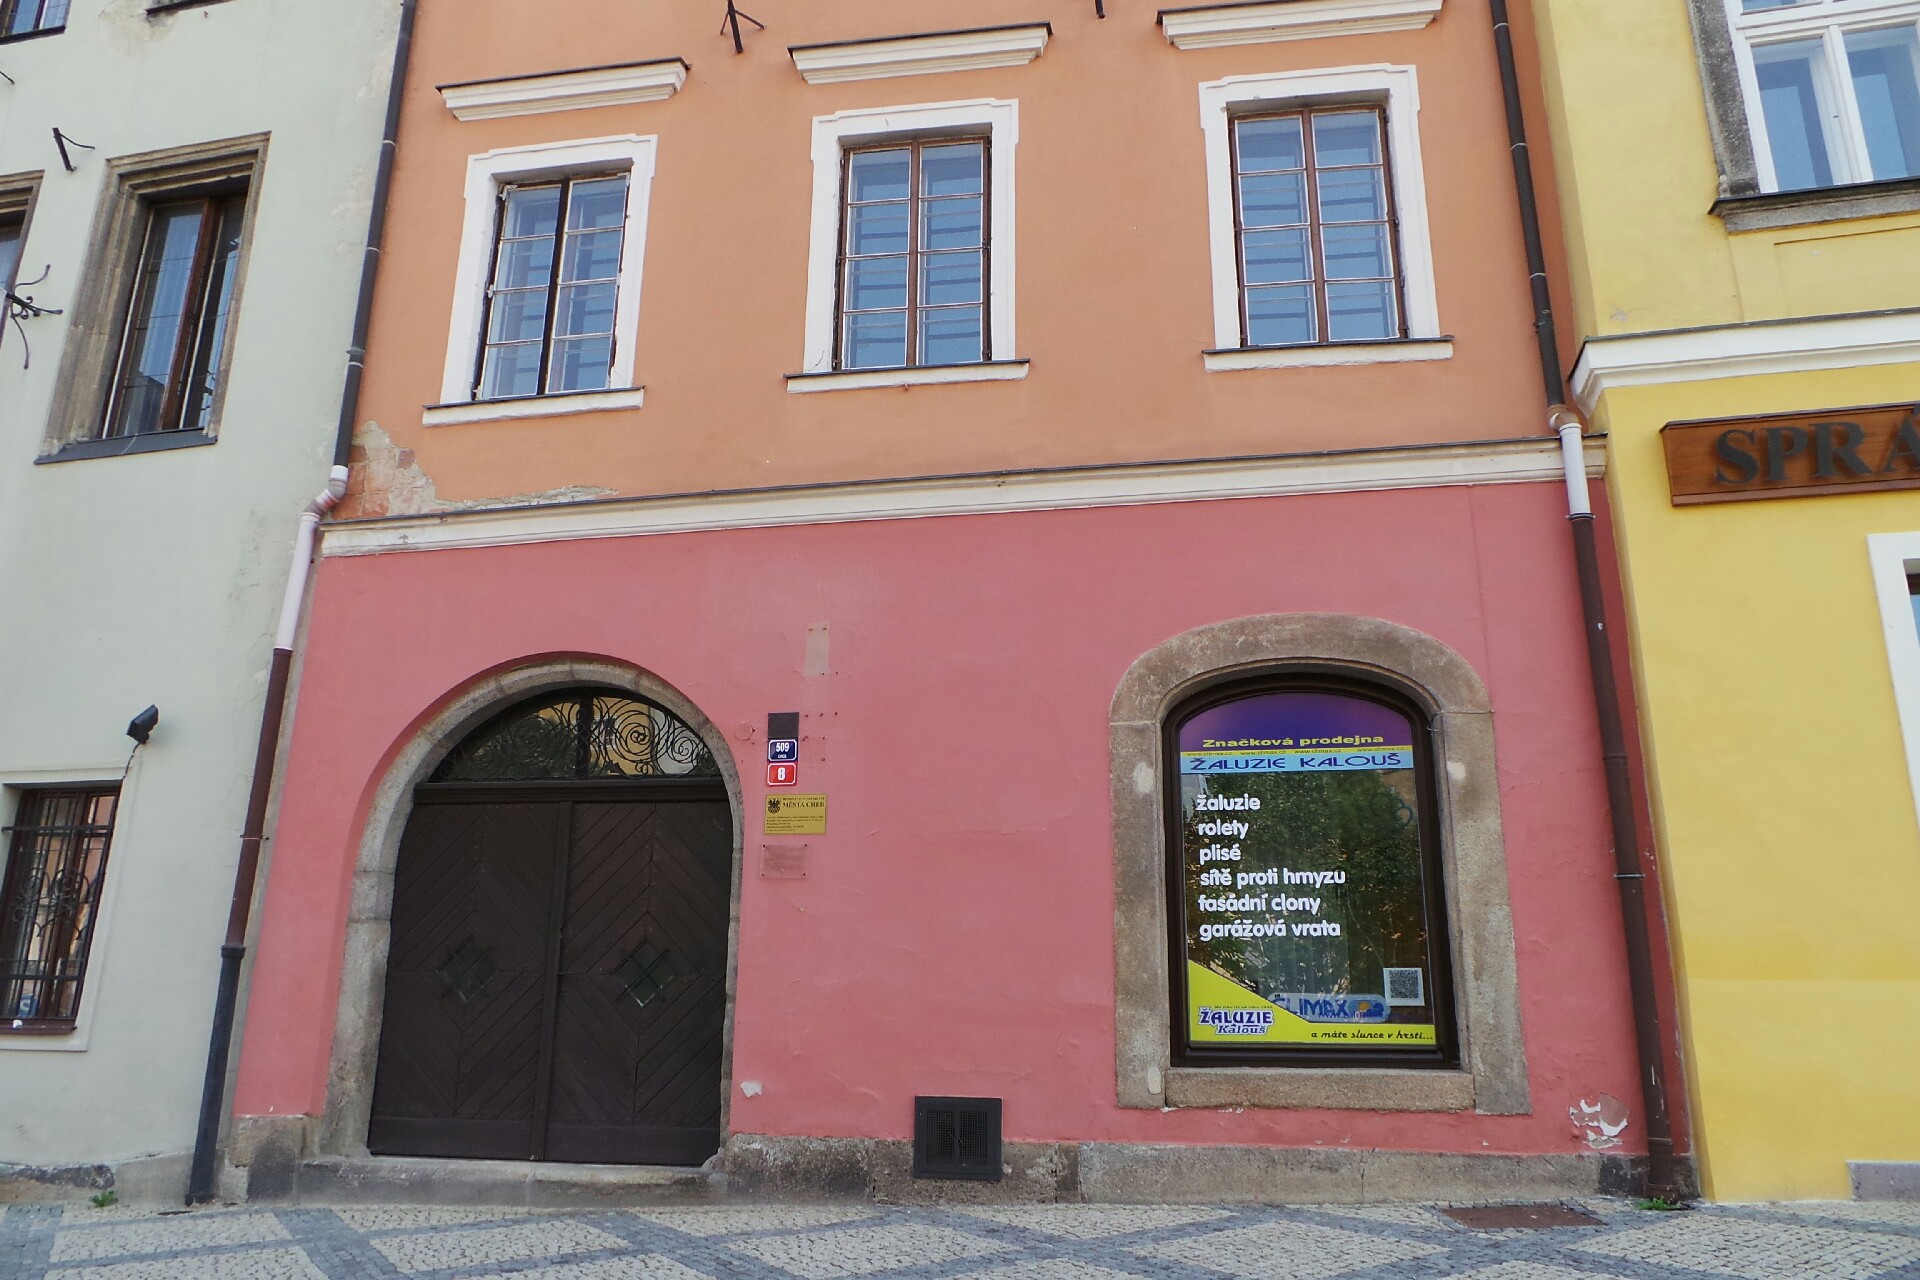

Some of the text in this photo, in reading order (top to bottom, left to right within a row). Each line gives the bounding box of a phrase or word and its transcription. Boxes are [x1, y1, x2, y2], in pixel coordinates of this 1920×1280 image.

[776, 742, 790, 753] 509
[1202, 735, 1384, 748] Značková prodejna
[1190, 752, 1402, 771] ŽALUZIE KALOUŠ
[1195, 793, 1261, 811] žaluzie
[1198, 819, 1249, 840] rolety
[1199, 843, 1242, 866] plisé
[1199, 867, 1346, 889] sítě proti hmyzu
[1197, 893, 1321, 916] fasádní clony
[1199, 918, 1341, 942] garážová vrata
[1200, 1007, 1273, 1025] ŽALUZIE
[1216, 1024, 1267, 1035] Kalouš
[1311, 1031, 1318, 1039] a
[1321, 1030, 1348, 1039] máte
[1350, 1029, 1385, 1039] slunce
